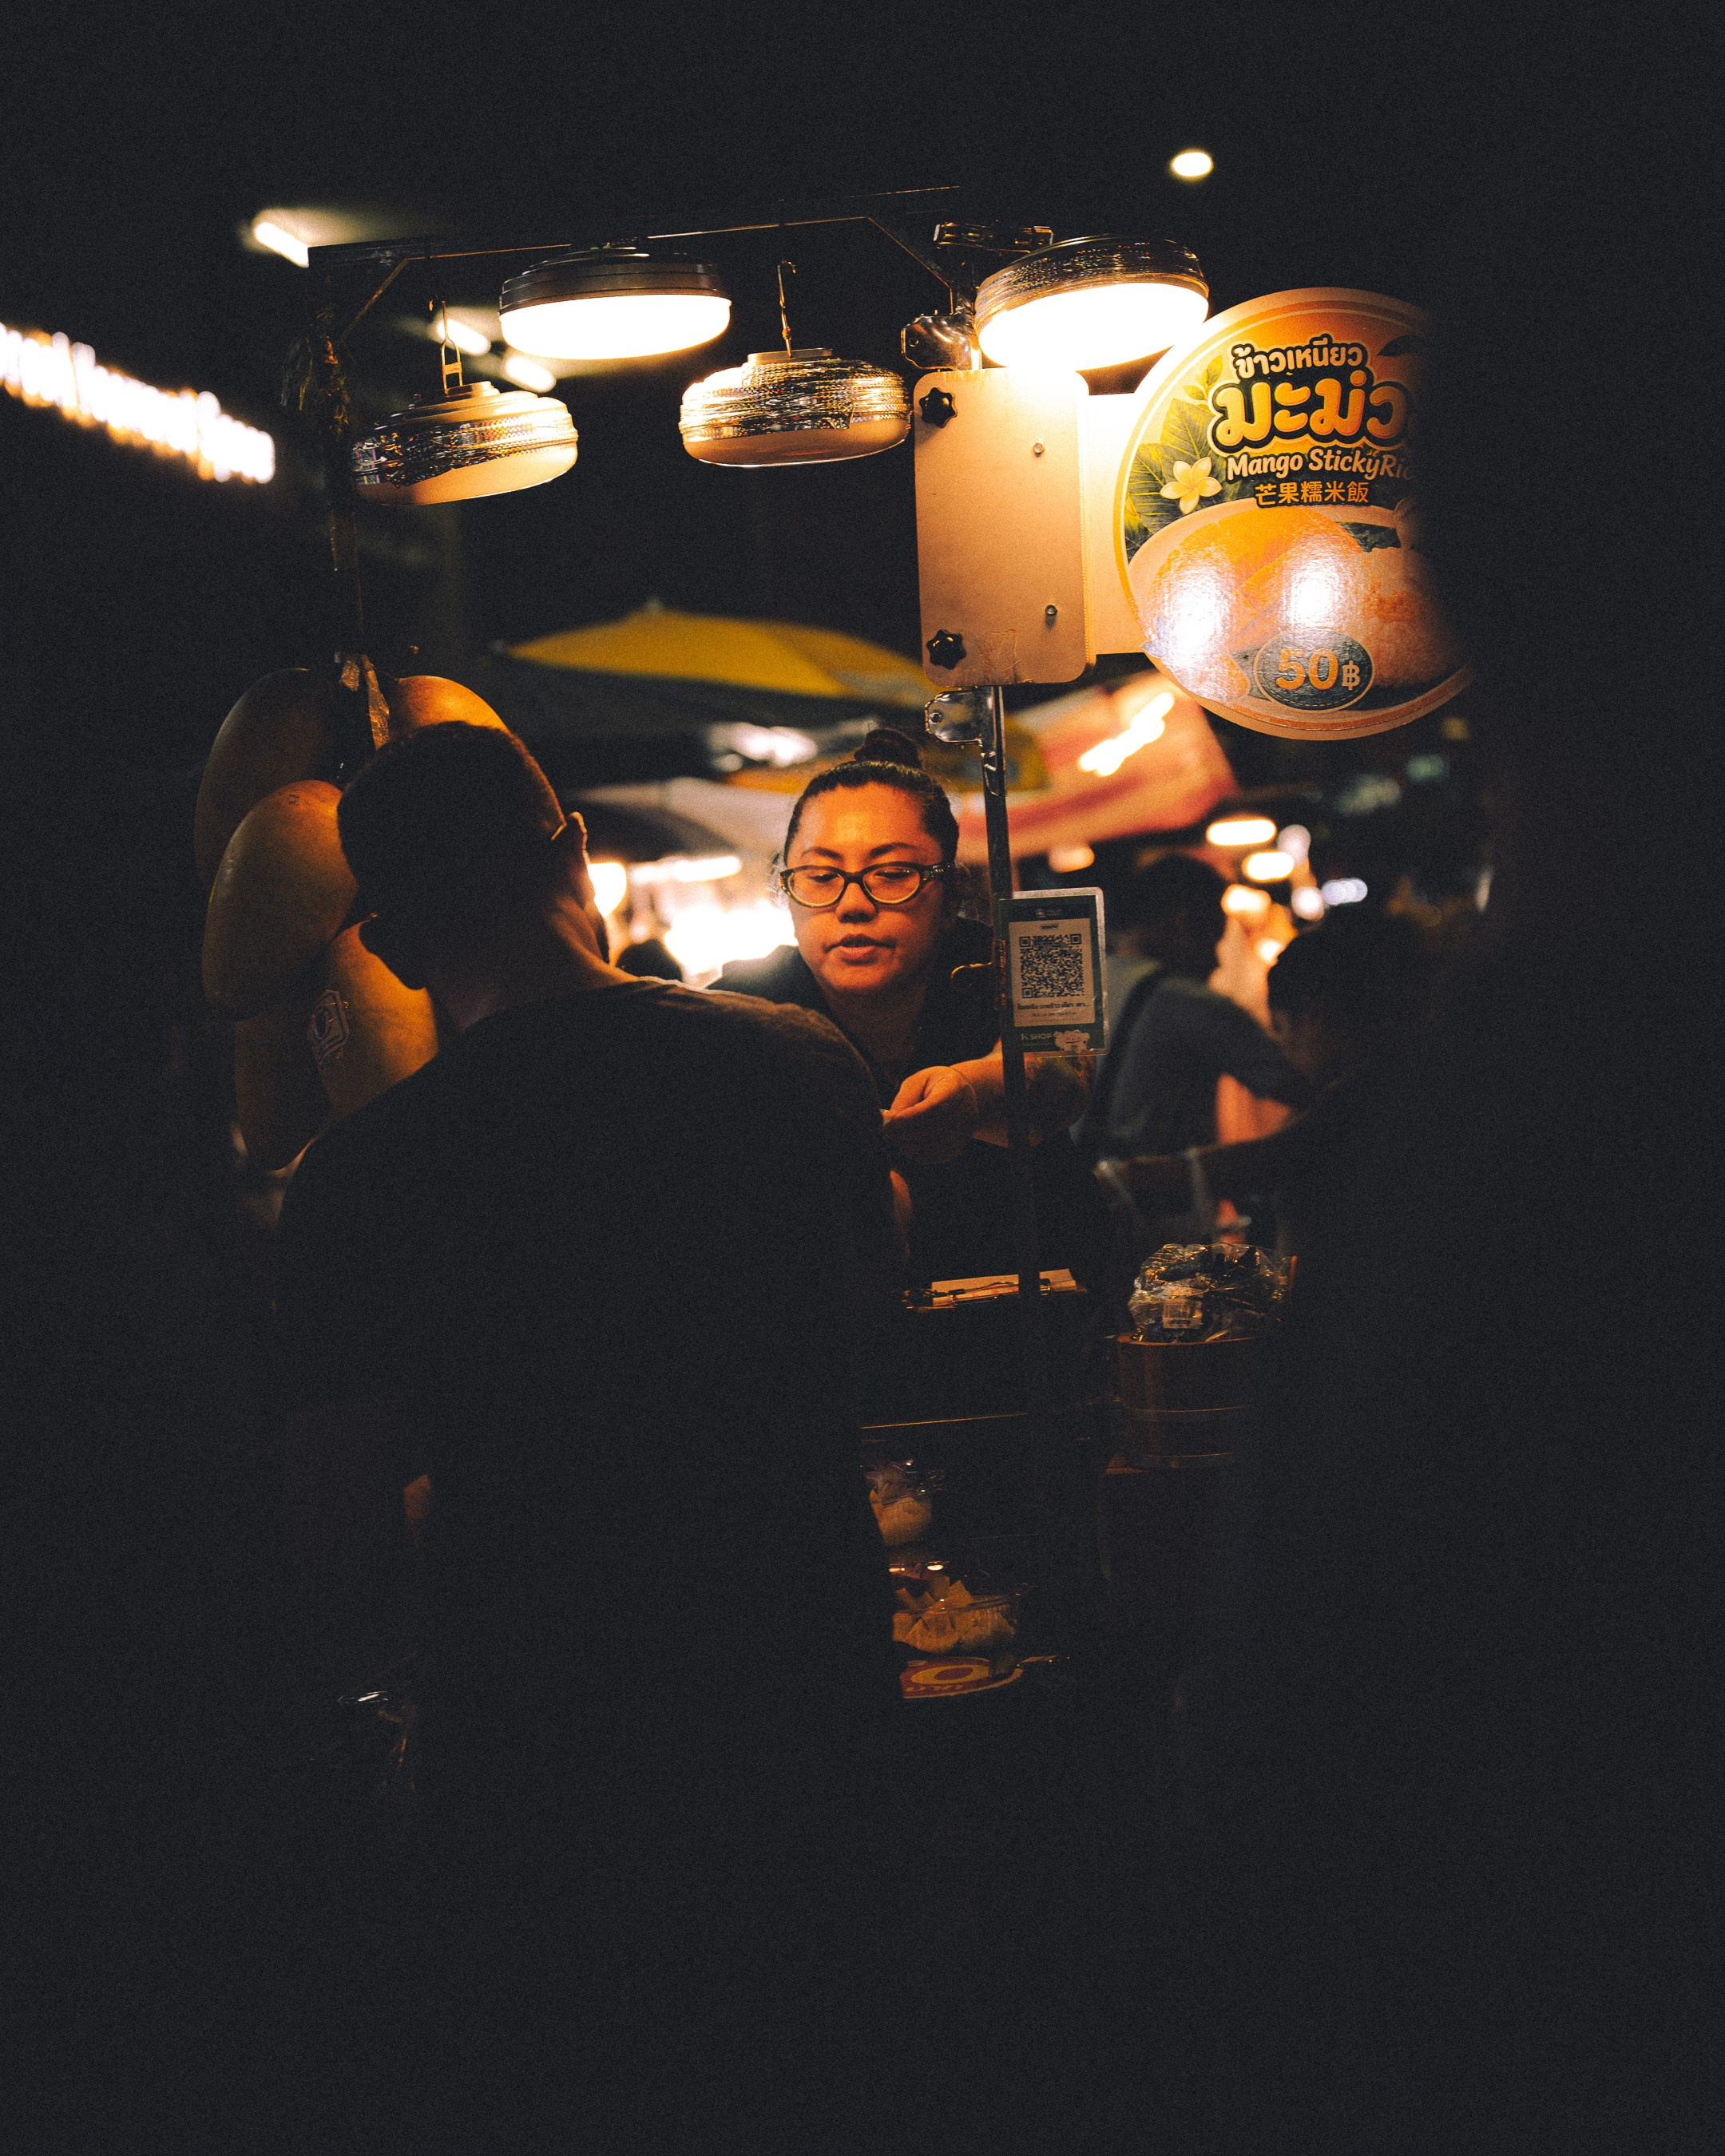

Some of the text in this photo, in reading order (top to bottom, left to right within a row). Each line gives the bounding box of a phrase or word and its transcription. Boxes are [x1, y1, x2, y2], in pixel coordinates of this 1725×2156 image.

[1235, 338, 1362, 378] ข้าวเหนียว
[1215, 369, 1408, 447] มะม่ว
[1227, 453, 1303, 480] Mango
[1255, 479, 1370, 506] 芒果糯米飯
